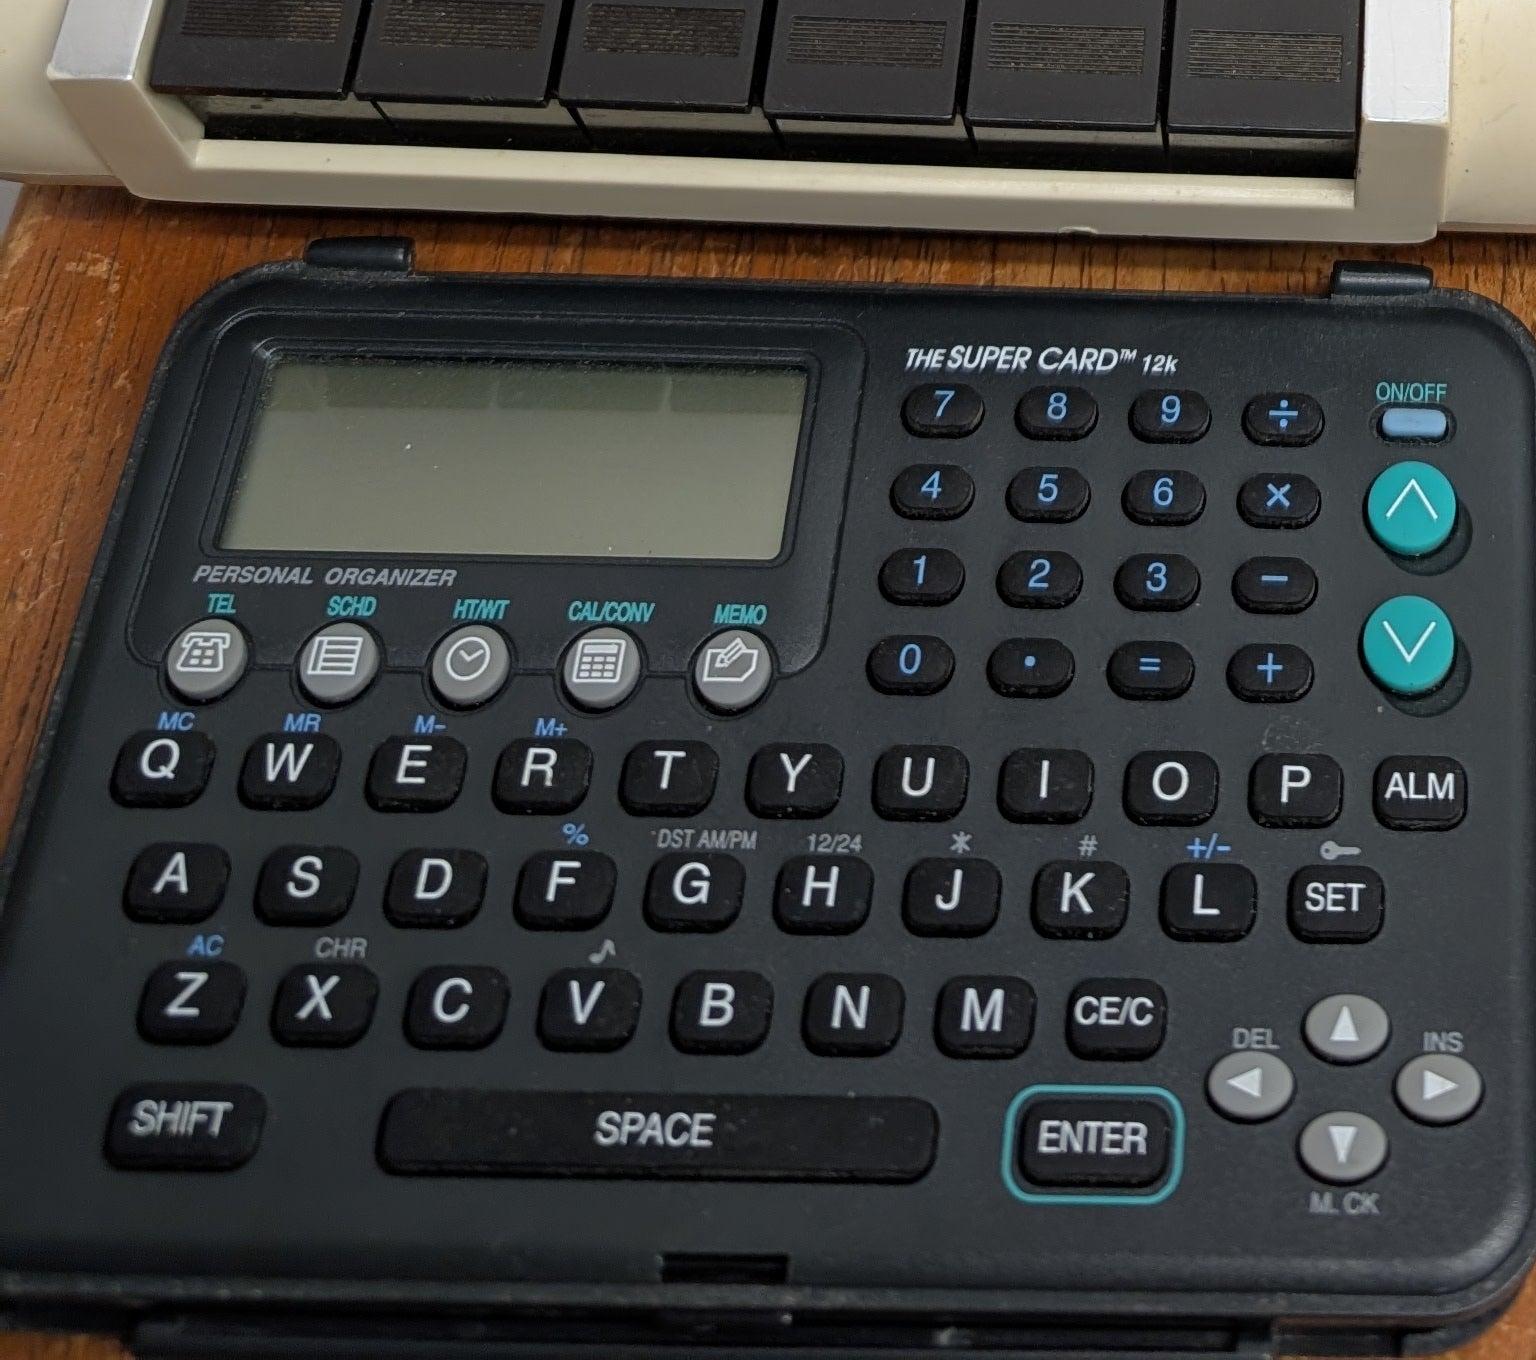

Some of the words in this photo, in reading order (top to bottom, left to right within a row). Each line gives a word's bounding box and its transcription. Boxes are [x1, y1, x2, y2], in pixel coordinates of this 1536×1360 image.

[906, 347, 944, 369] THE
[946, 345, 1032, 371] SUPER
[1142, 354, 1178, 373] 12k
[934, 390, 955, 418] 7
[1047, 392, 1067, 421] 8
[1376, 383, 1447, 402] ON/OFF
[1161, 395, 1181, 424] 9
[920, 470, 942, 500] 4
[1037, 473, 1059, 503] 5
[1153, 477, 1174, 507] 6
[192, 566, 314, 585] PERSONAL
[325, 568, 457, 587] ORGANIZER
[913, 555, 927, 585] 1
[1028, 558, 1051, 588] 2
[1146, 562, 1167, 593] 3
[208, 594, 236, 614] TEL
[327, 597, 377, 616] SCHD
[454, 599, 509, 619] HT/WT
[569, 601, 654, 621] CAL/CONV
[714, 605, 767, 624] MEMO
[899, 643, 922, 675] 0
[1139, 657, 1161, 672] =
[1256, 652, 1283, 683] +
[158, 712, 194, 730] MC
[284, 714, 321, 731] MR
[536, 719, 568, 737] M+
[140, 738, 180, 779] Q
[266, 742, 314, 782] W
[396, 744, 433, 784] E
[521, 747, 558, 787] R
[654, 750, 687, 790] T
[780, 752, 812, 793] Y
[901, 756, 936, 797] U
[1039, 760, 1050, 799] I
[1152, 761, 1189, 801] O
[1280, 764, 1312, 803] P
[1385, 774, 1454, 800] ALM
[562, 824, 589, 844] %
[658, 830, 694, 848] DST
[697, 830, 757, 850] AM/PM
[808, 833, 861, 853] 12/24
[1079, 836, 1097, 856] #
[1187, 837, 1231, 859] +/-
[153, 852, 188, 894] A
[287, 855, 323, 898] S
[415, 858, 453, 900] D
[546, 860, 582, 902] F
[673, 861, 711, 905] G
[802, 865, 840, 907] H
[935, 868, 963, 911] J
[1060, 871, 1095, 913] K
[1192, 874, 1220, 915] L
[1305, 884, 1365, 912] SET
[187, 936, 224, 955] AC
[316, 938, 367, 958] CHR
[165, 971, 209, 1016] Z
[297, 974, 340, 1020] X
[433, 977, 473, 1023] C
[570, 980, 605, 1024] V
[699, 982, 735, 1027] B
[831, 984, 870, 1029] N
[961, 987, 1005, 1032] M
[1074, 997, 1153, 1027] CE/C
[1232, 1027, 1279, 1051] DEL
[1423, 1032, 1463, 1053] INS
[128, 1101, 233, 1138] SHIFT
[594, 1112, 714, 1148] SPACE
[1038, 1122, 1147, 1155] ENTER
[1345, 1193, 1379, 1214] CK
